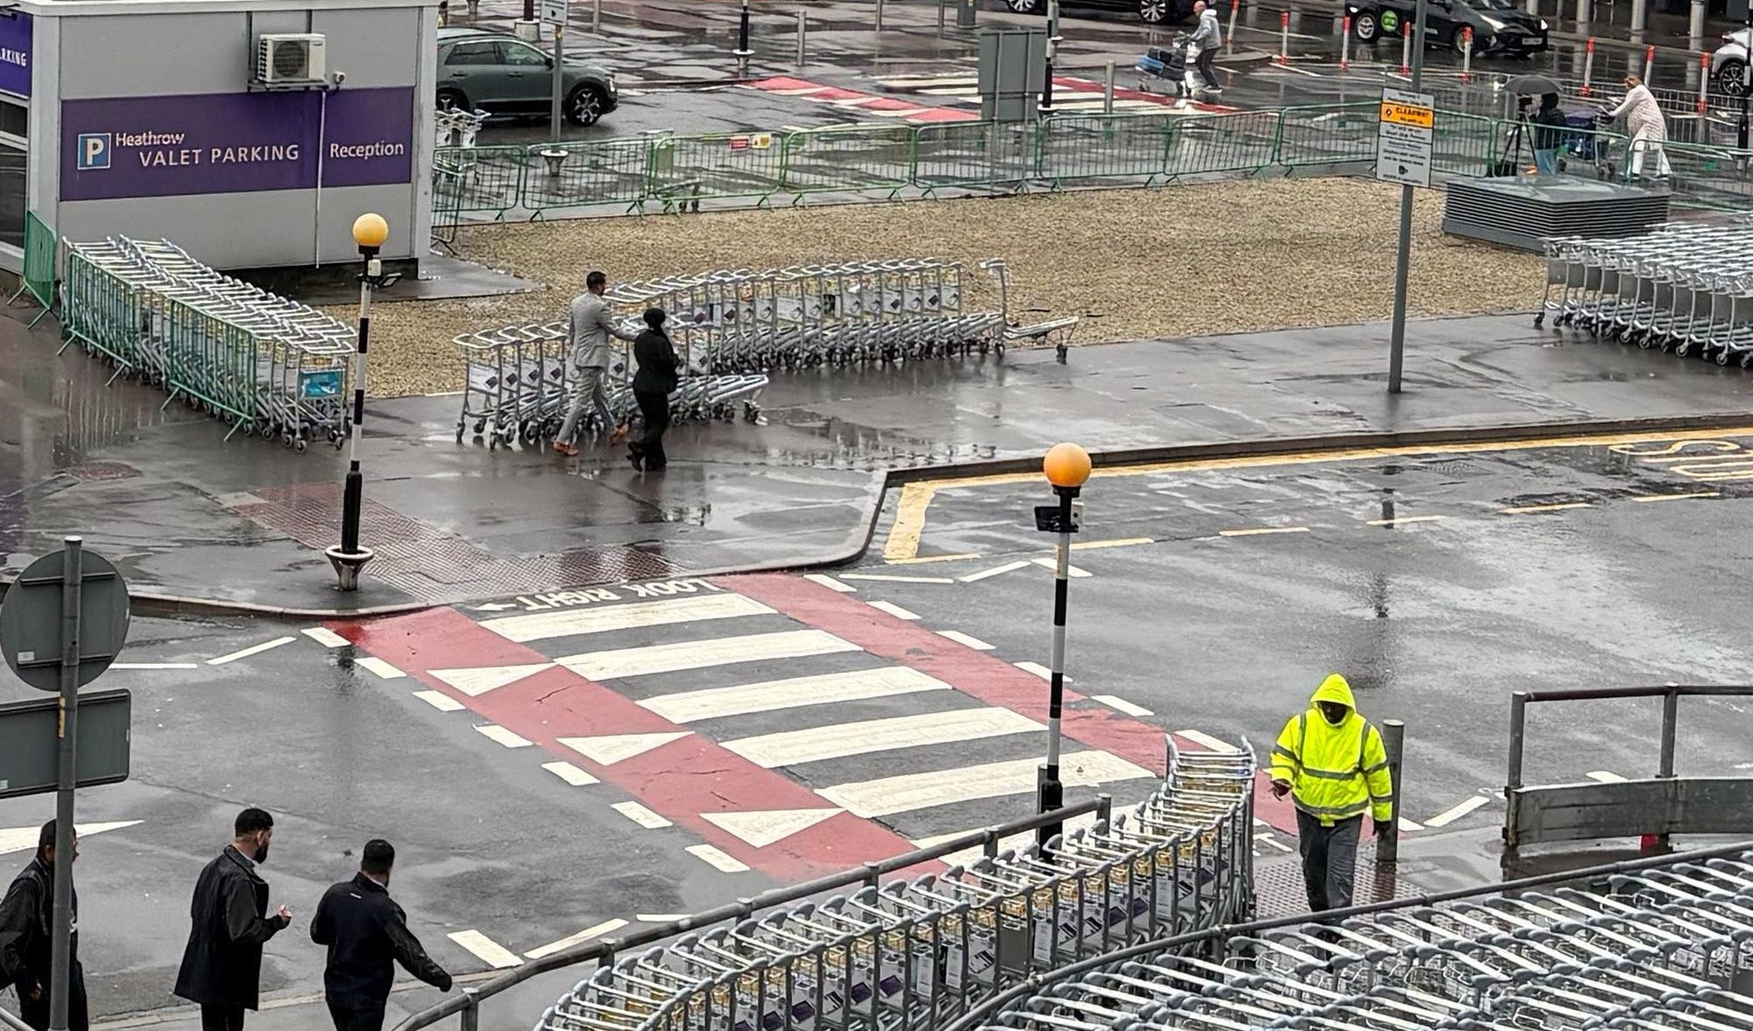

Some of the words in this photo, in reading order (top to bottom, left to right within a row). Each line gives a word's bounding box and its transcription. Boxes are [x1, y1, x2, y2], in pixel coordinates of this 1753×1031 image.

[115, 131, 185, 148] Heathrow
[329, 140, 404, 162] Reception
[139, 149, 202, 168] VALET
[210, 144, 299, 165] PARKING
[514, 588, 622, 612] RIGHT
